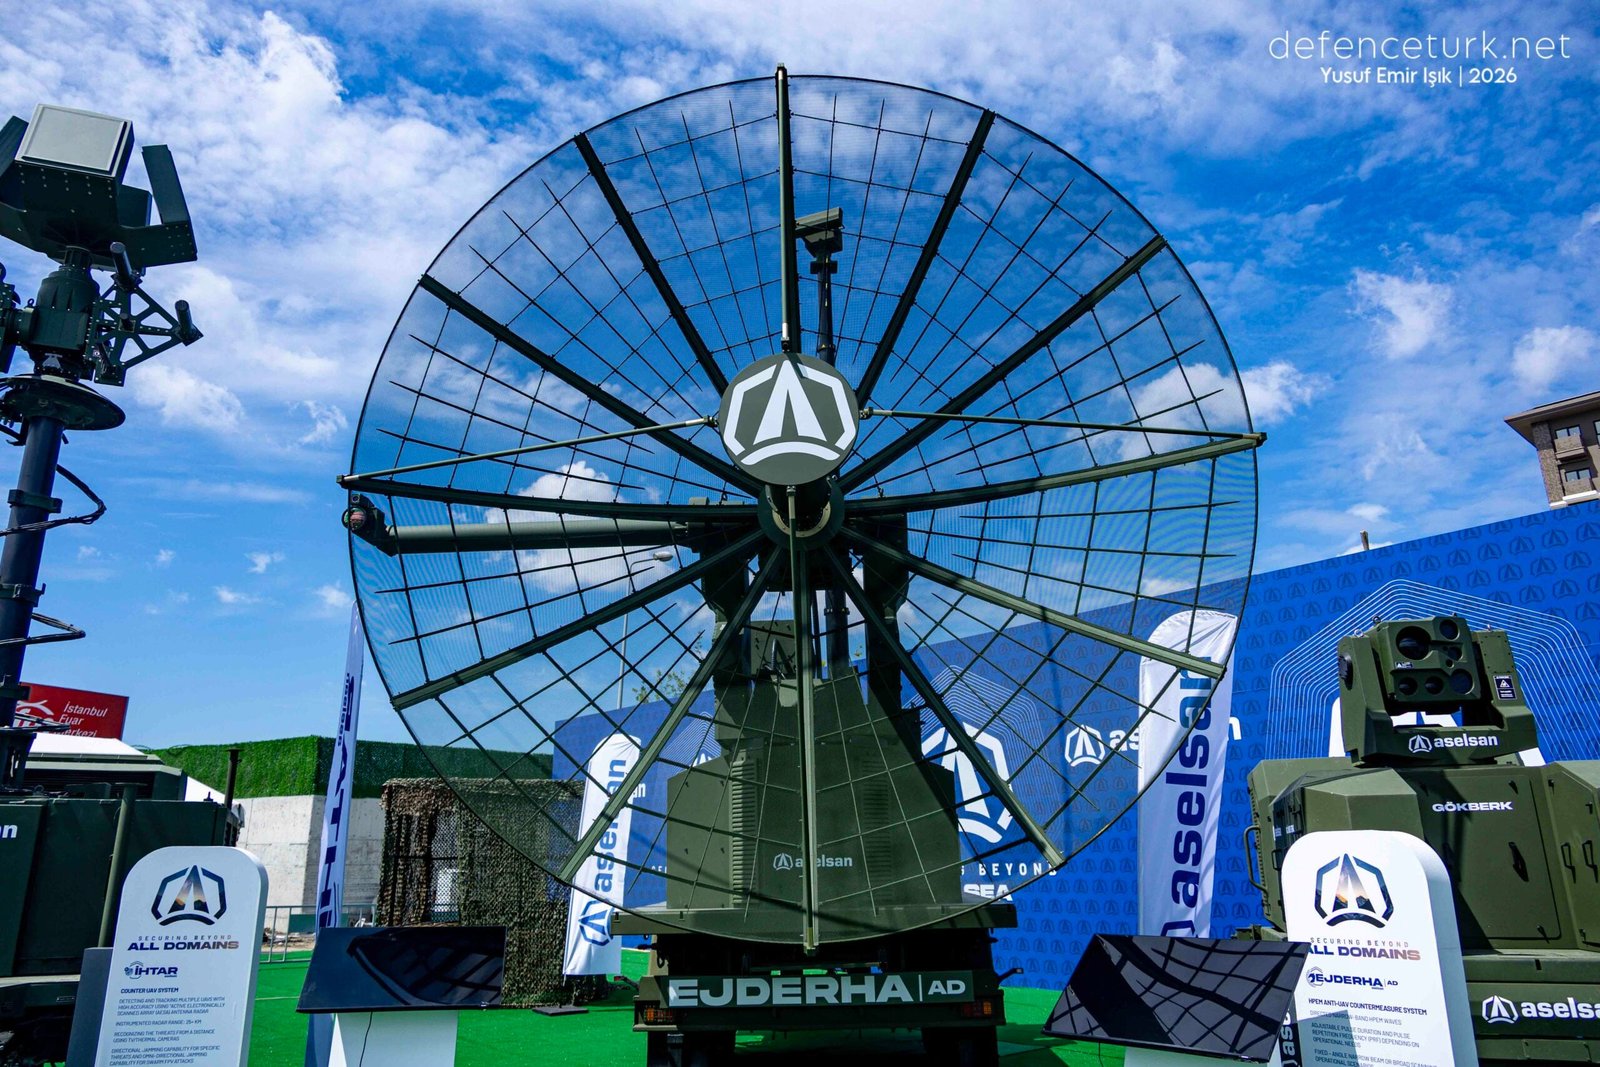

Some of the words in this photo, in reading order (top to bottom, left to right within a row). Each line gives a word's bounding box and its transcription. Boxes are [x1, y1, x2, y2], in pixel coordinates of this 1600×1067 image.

[63, 701, 108, 717] İstanbul
[59, 714, 84, 726] Fuar
[62, 728, 97, 737] erkezi
[1434, 733, 1498, 748] aselsan
[1432, 801, 1513, 812] GÖKBERK
[594, 759, 627, 893] asean
[795, 854, 853, 868] aelsan
[127, 942, 160, 951] ALL
[163, 941, 239, 950] DOMAINS
[1310, 937, 1360, 945] SECURING
[1367, 940, 1409, 948] BEYOND
[1337, 946, 1421, 960] DOMAINS
[134, 965, 178, 976] İHTAR
[1315, 973, 1383, 987] EJDERHA
[668, 975, 914, 1007] EJDERHA
[928, 980, 971, 995] AD
[1324, 999, 1349, 1008] ANTI-UAV
[1350, 1002, 1402, 1013] COUNTERMEASURE
[1403, 1007, 1427, 1015] SYSTEM
[1521, 997, 1600, 1019] asels
